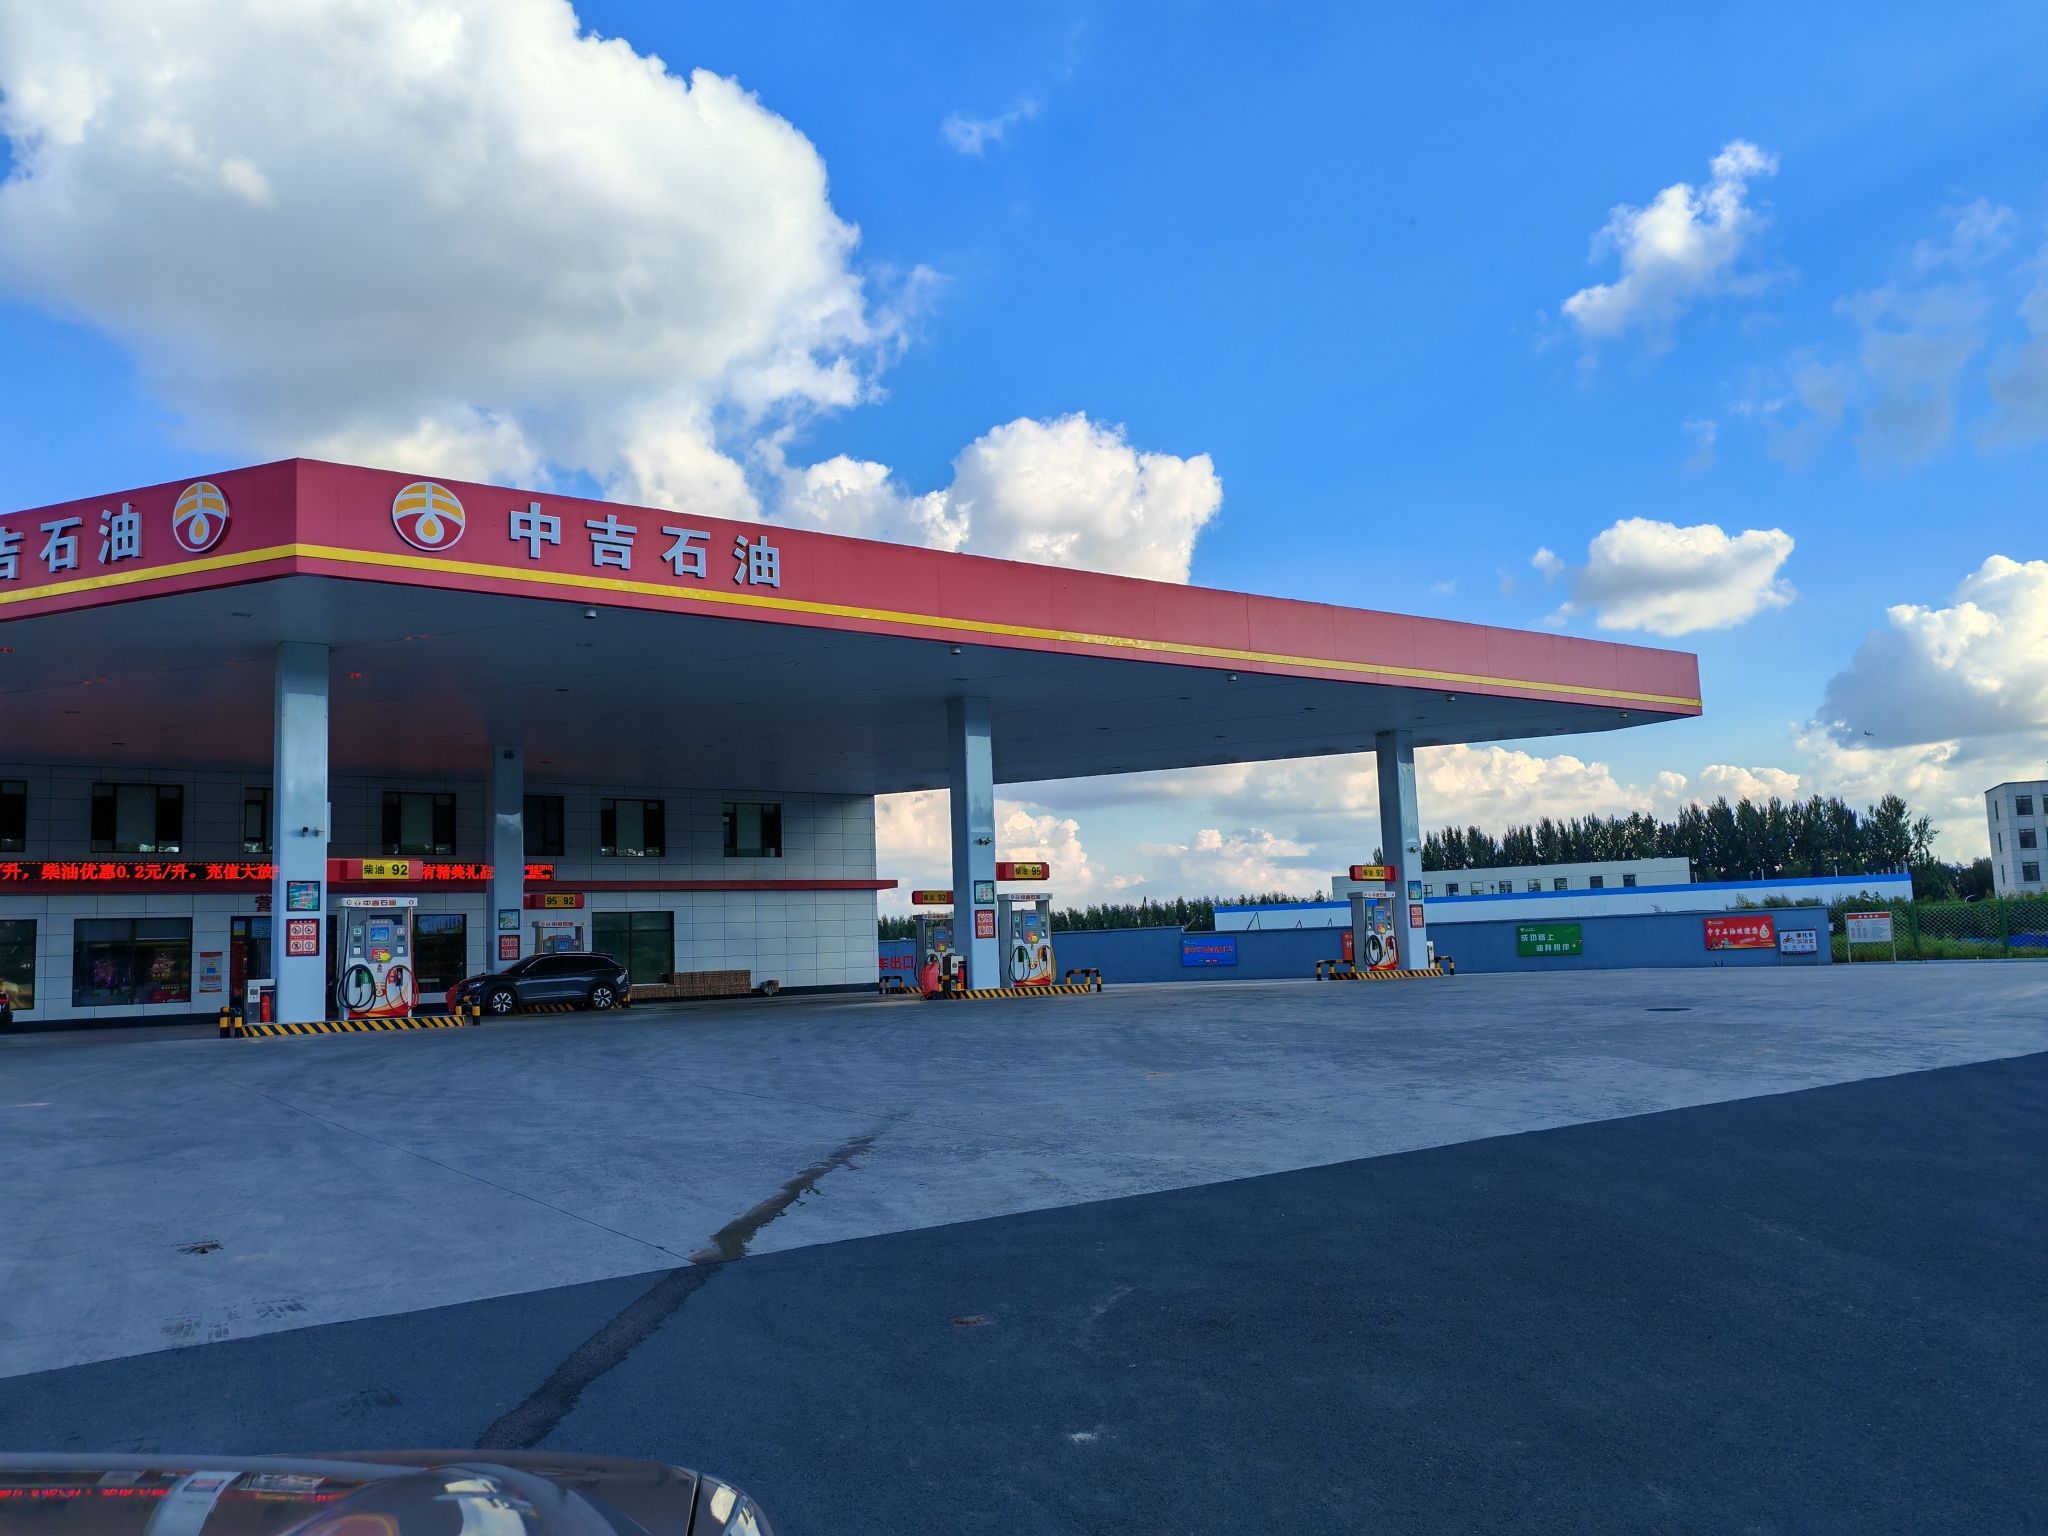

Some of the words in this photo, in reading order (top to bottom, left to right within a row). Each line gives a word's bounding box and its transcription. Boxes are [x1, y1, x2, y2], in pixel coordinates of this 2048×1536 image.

[510, 502, 781, 587] 中吉石油
[364, 864, 385, 875] 柴油
[392, 864, 408, 875] 92
[1031, 867, 1041, 875] 95
[546, 897, 557, 905] 95
[563, 897, 575, 905] 92
